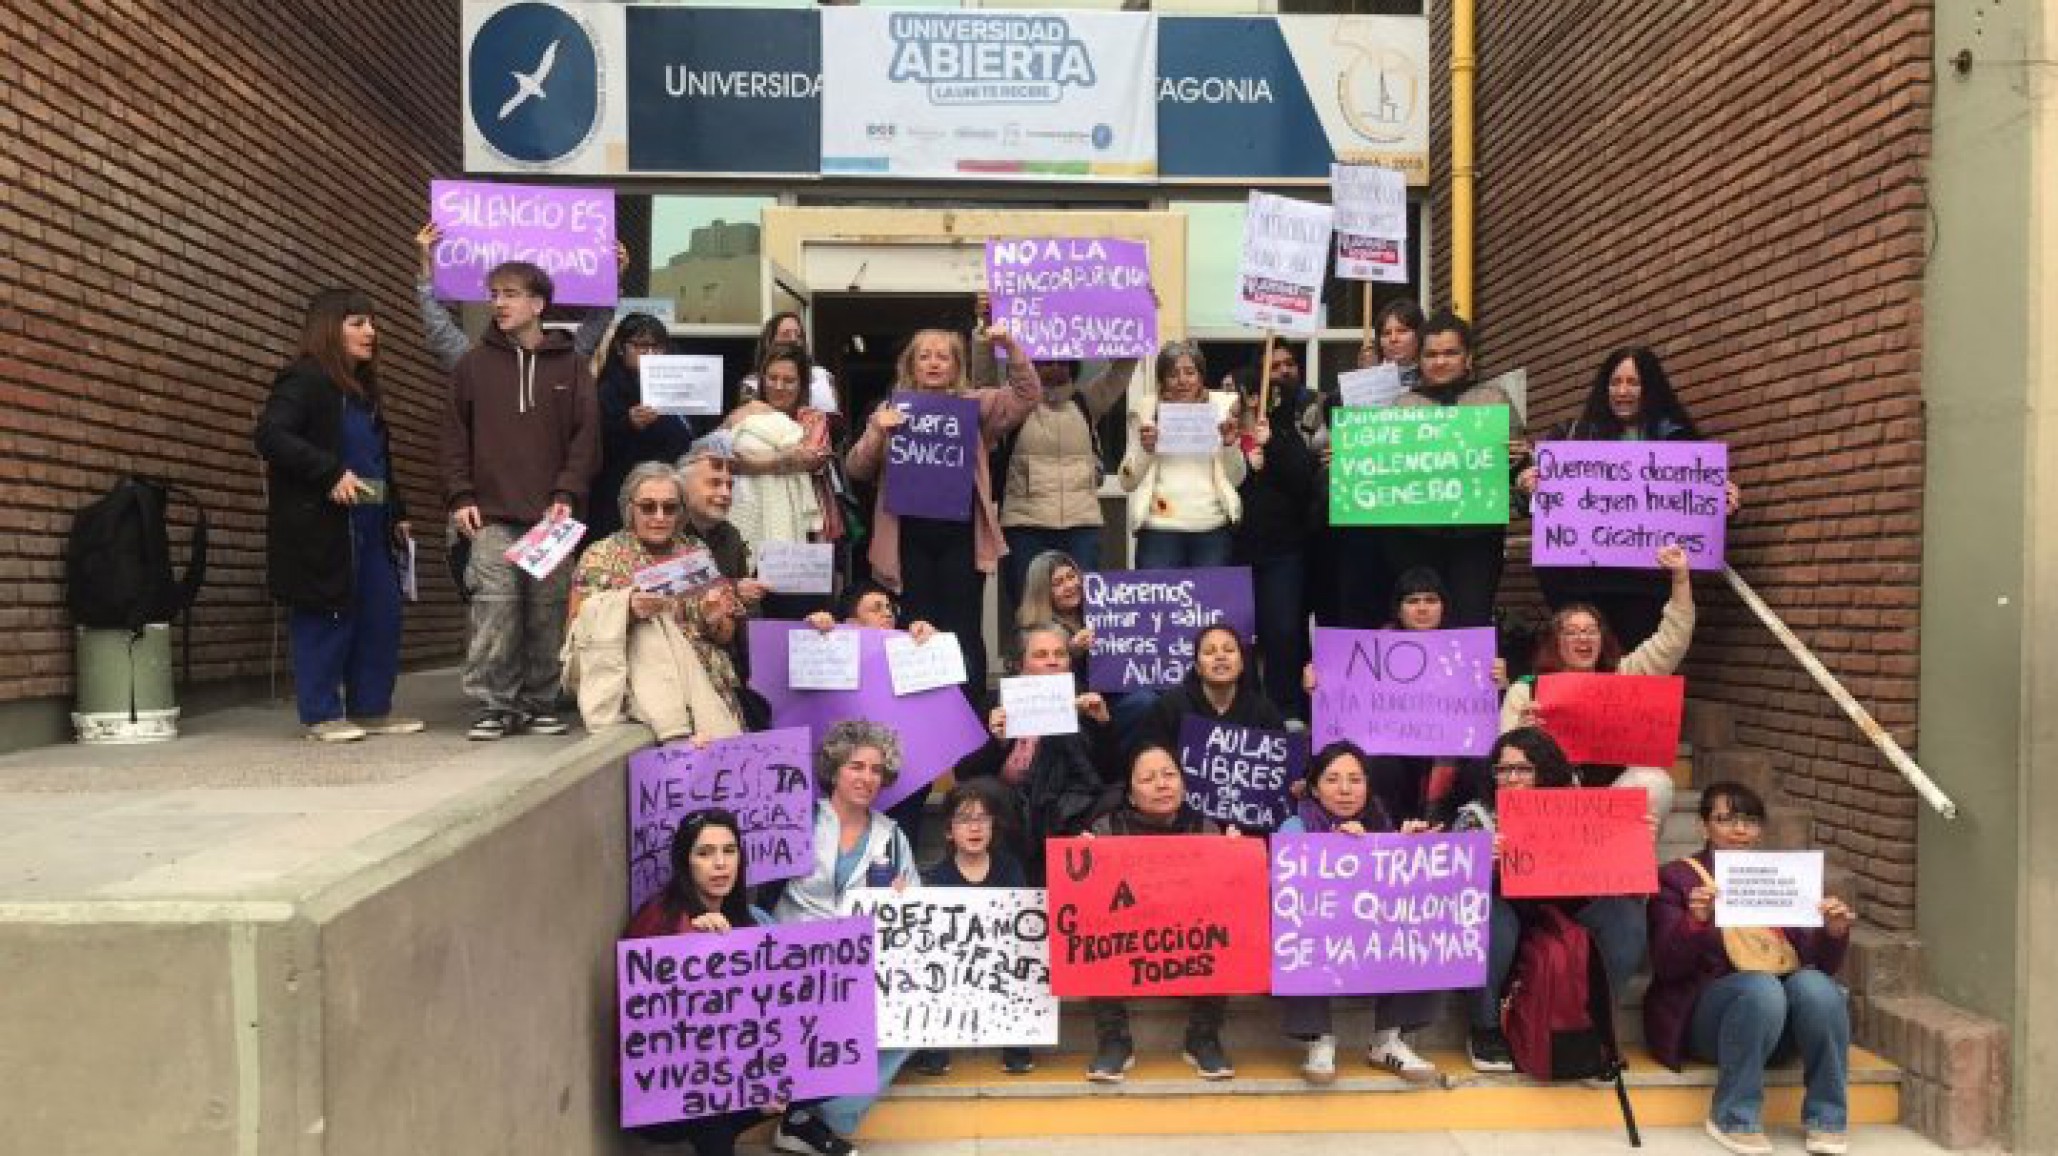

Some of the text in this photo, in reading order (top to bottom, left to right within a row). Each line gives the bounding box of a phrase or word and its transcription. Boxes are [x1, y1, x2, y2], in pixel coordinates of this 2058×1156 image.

[895, 17, 1065, 41] UNIVERSIDAD
[892, 44, 1093, 82] ABIERTA
[439, 190, 607, 232] SILENCIO ES
[994, 240, 1107, 267] NO A LA
[1011, 297, 1044, 316] DE
[1070, 314, 1145, 342] SANCCI
[890, 434, 965, 468] SANCCI
[1342, 425, 1403, 450] LIBRE
[1340, 447, 1495, 478] VIOLENCIA DE
[1645, 483, 1720, 517] huellas
[1545, 524, 1580, 551] NO
[1083, 571, 1196, 608] Queremos
[1345, 637, 1428, 685] NO
[1205, 726, 1288, 762] AULAS
[1181, 745, 1288, 791] LIBRES
[1065, 845, 1094, 882] U
[1319, 846, 1360, 880] LO
[1371, 841, 1474, 888] TRAEN
[1502, 847, 1536, 876] NO
[1108, 879, 1137, 913] A
[1274, 886, 1338, 928] QUE
[1353, 886, 1490, 928] QUILOMBO
[625, 931, 874, 986] Necesitamos
[1274, 926, 1487, 972] SE VA A ARMAR
[1128, 952, 1217, 986] TODES
[624, 983, 744, 1020] entrar
[776, 969, 858, 1008] salir
[624, 1014, 819, 1060] enteras y
[633, 1035, 862, 1091] vivas de las
[682, 1074, 796, 1115] aulas
